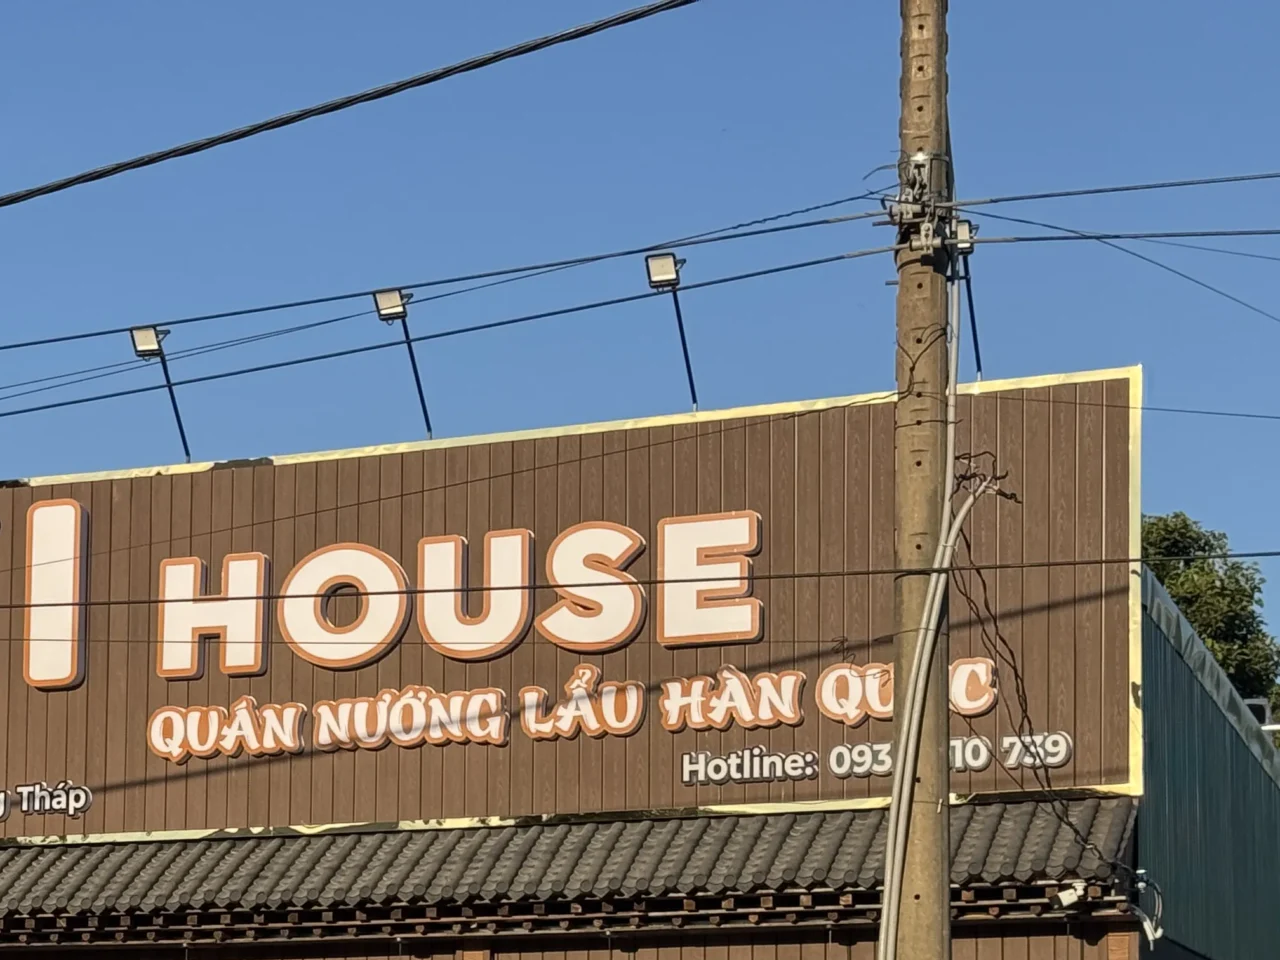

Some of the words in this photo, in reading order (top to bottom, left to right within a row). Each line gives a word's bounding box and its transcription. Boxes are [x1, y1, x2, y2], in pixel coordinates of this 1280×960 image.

[156, 510, 761, 679] HOUSE
[148, 696, 306, 763] QUÁN
[314, 685, 509, 751] NƯỚNG
[519, 664, 644, 740] LẨU
[660, 664, 806, 732] HÀN
[816, 658, 997, 727] QUC
[682, 747, 817, 783] Hotline:
[1001, 732, 1071, 769] 739
[16, 780, 88, 816] Tháp
